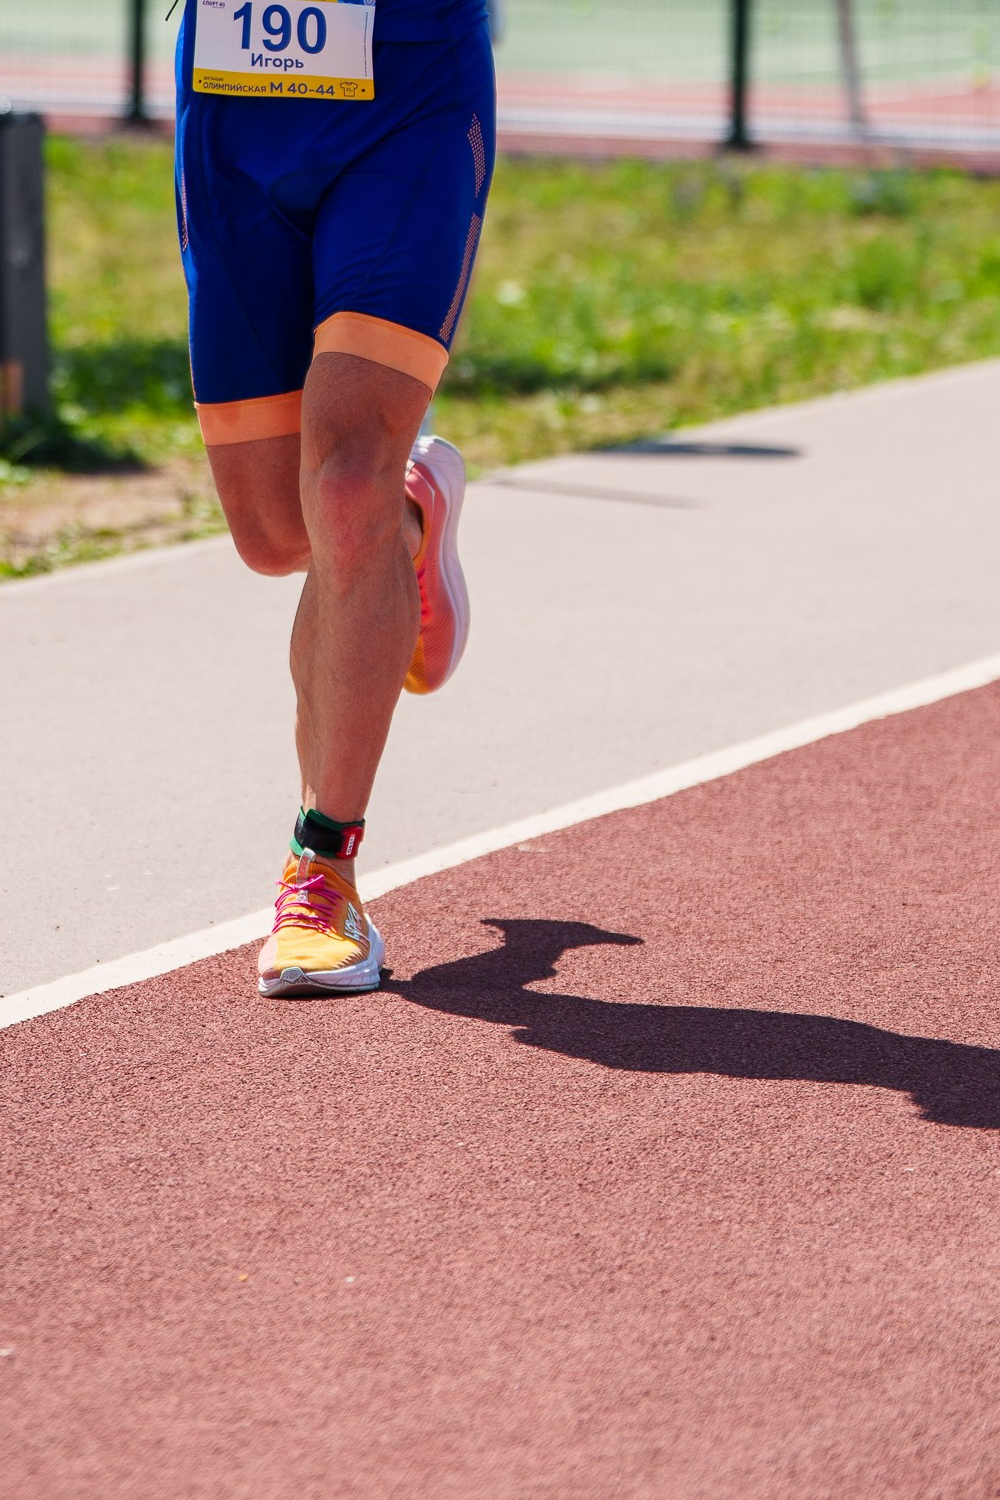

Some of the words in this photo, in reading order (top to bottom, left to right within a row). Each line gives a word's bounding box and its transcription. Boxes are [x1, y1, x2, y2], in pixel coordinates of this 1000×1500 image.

[233, 1, 327, 55] 190
[251, 53, 304, 71] Игорь
[202, 80, 267, 94] ОЛИМПИЙСКАЯ
[269, 82, 283, 93] М
[287, 83, 336, 96] 40-44
